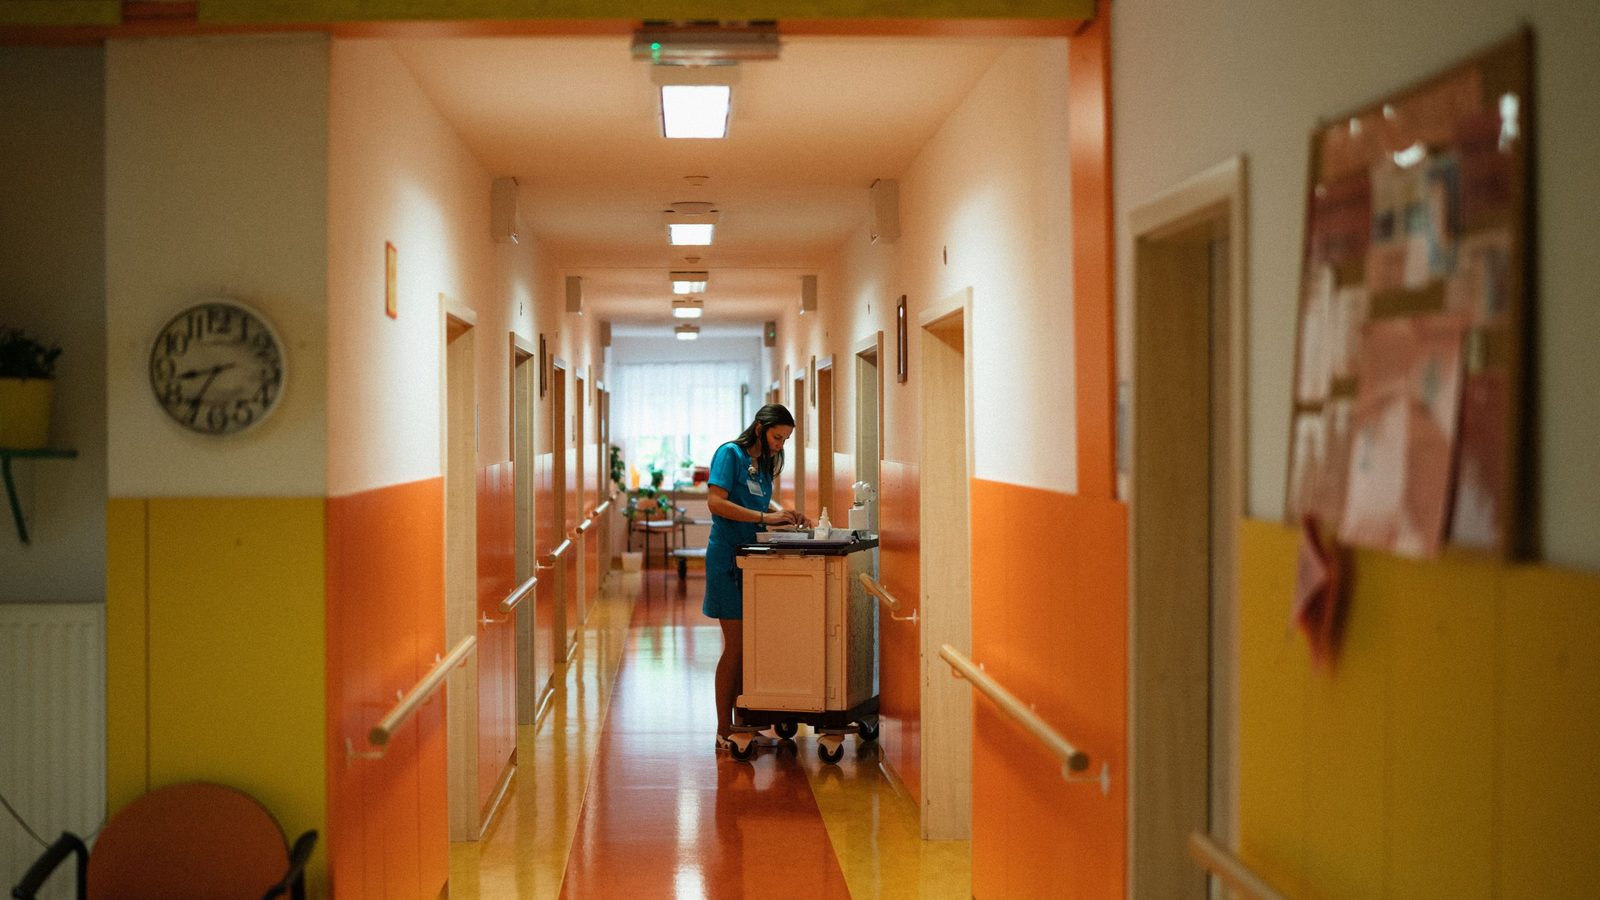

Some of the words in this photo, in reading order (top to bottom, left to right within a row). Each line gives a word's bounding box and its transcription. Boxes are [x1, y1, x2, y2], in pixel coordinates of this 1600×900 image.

[187, 314, 203, 339] 11
[207, 308, 232, 334] 12
[241, 316, 248, 341] 1
[165, 332, 189, 356] 10
[252, 333, 271, 357] 2
[155, 358, 175, 381] 9
[261, 360, 282, 385] 3
[163, 384, 182, 404] 8
[253, 383, 270, 407] 4
[207, 404, 228, 431] 6
[233, 399, 253, 425] 5
